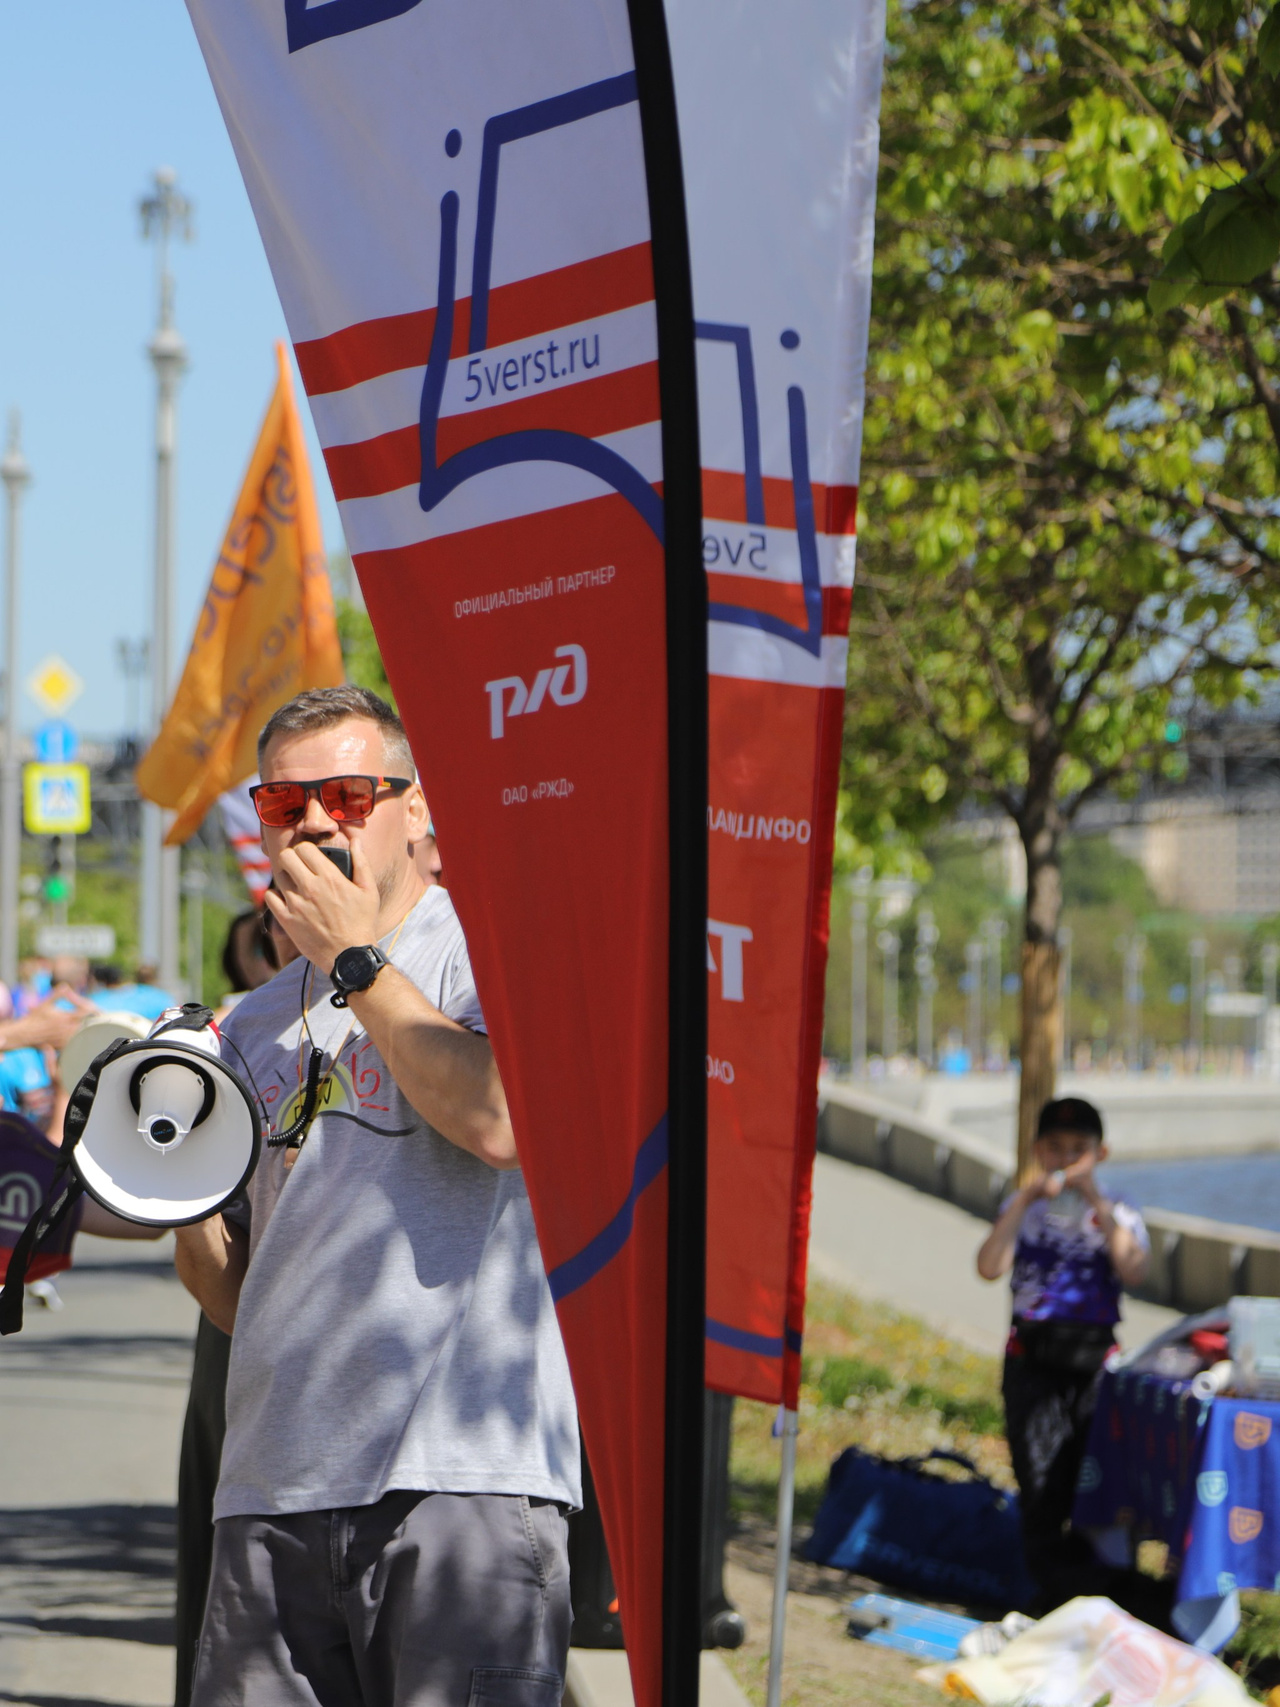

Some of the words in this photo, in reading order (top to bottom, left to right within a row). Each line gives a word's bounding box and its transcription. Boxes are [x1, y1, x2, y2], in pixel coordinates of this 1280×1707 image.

[465, 333, 600, 402] 5verst.ru
[454, 576, 554, 619] ОФИЦИАЛЬНЫЙ
[557, 565, 616, 595] ПАРТНЕР
[502, 785, 528, 806] ОАО
